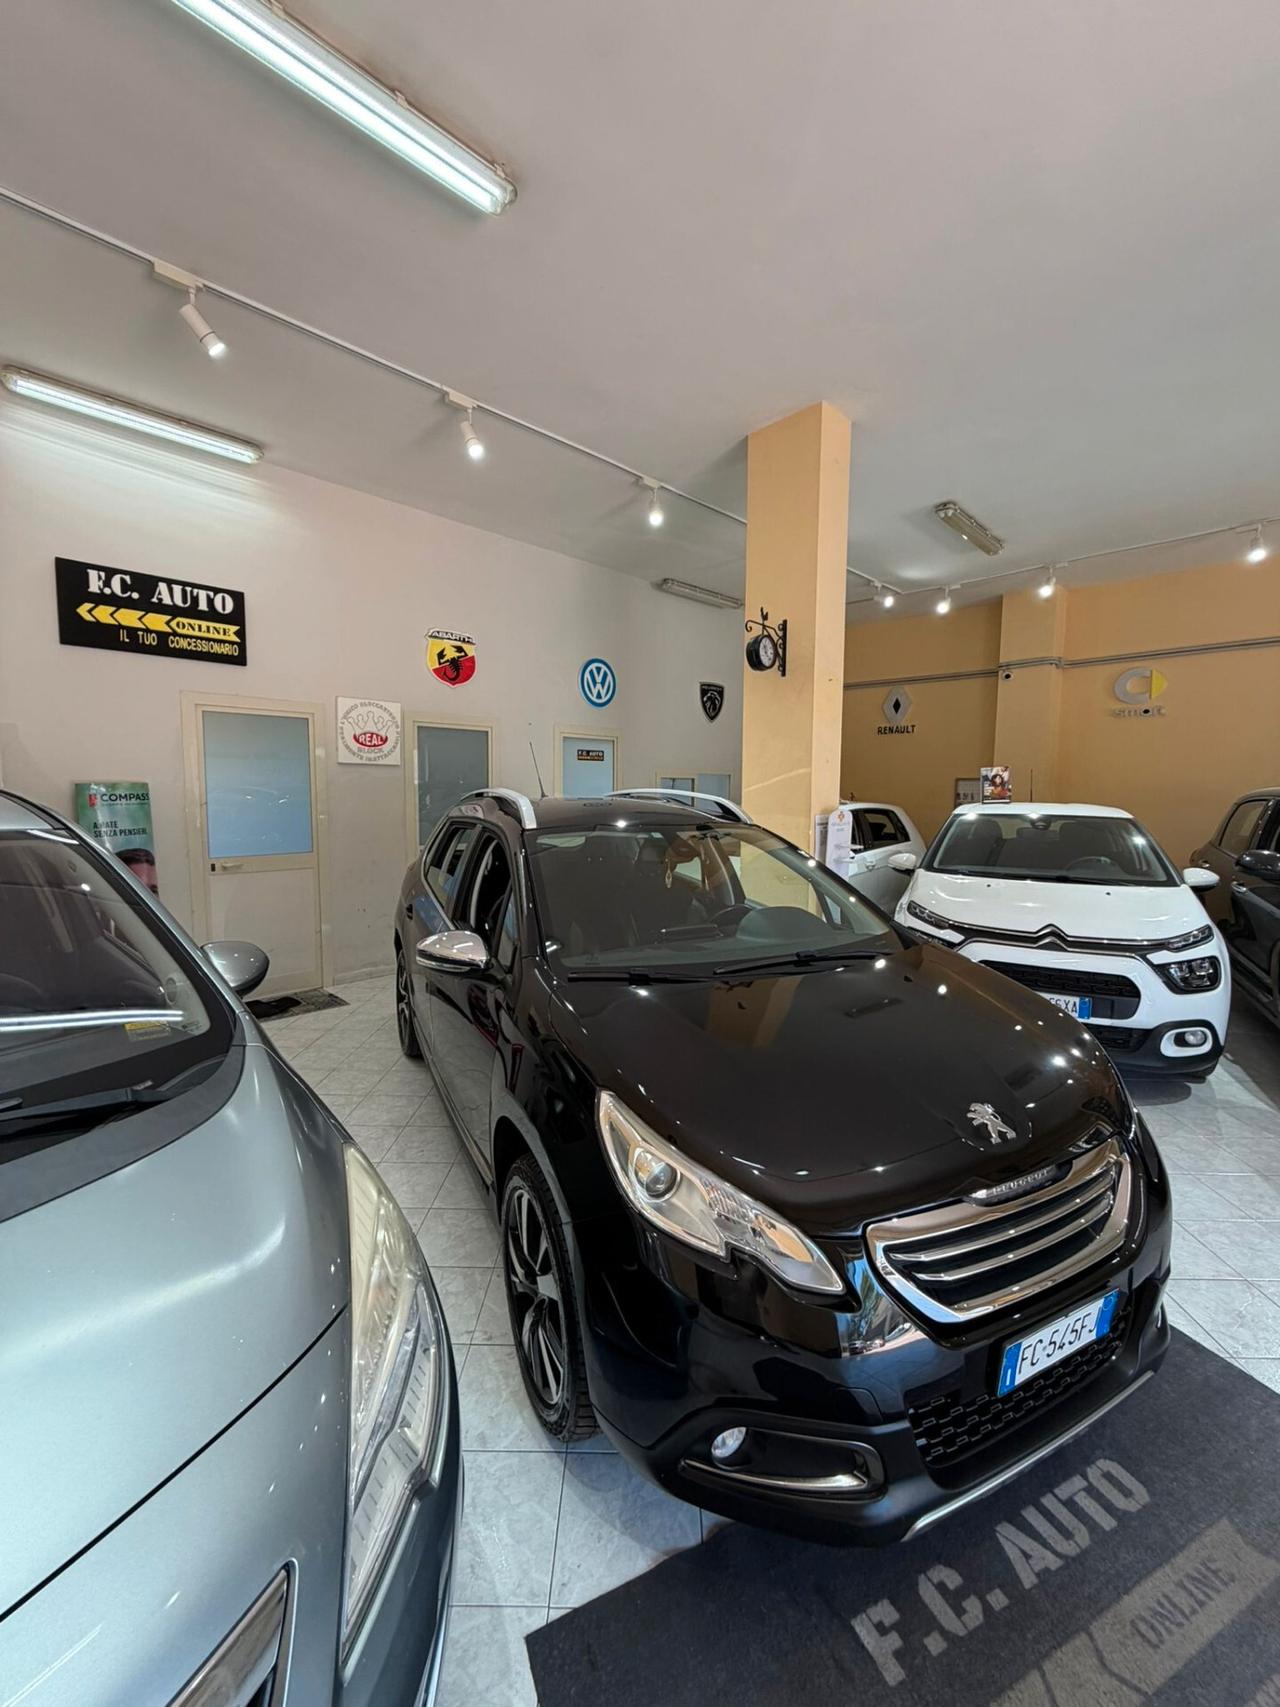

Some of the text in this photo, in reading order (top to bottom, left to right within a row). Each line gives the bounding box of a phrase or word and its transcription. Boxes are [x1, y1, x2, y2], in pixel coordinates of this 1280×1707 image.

[86, 568, 235, 615] F.C. AUTO
[175, 619, 232, 637] ONLINE
[119, 628, 239, 656] IL TUO CONCESSIONARIO
[358, 733, 385, 746] REAL
[877, 724, 916, 736] RENAULT
[101, 793, 150, 802] COMPASS
[850, 1458, 1151, 1687] F.C. AUTO
[1130, 1551, 1236, 1650] ONLINE
